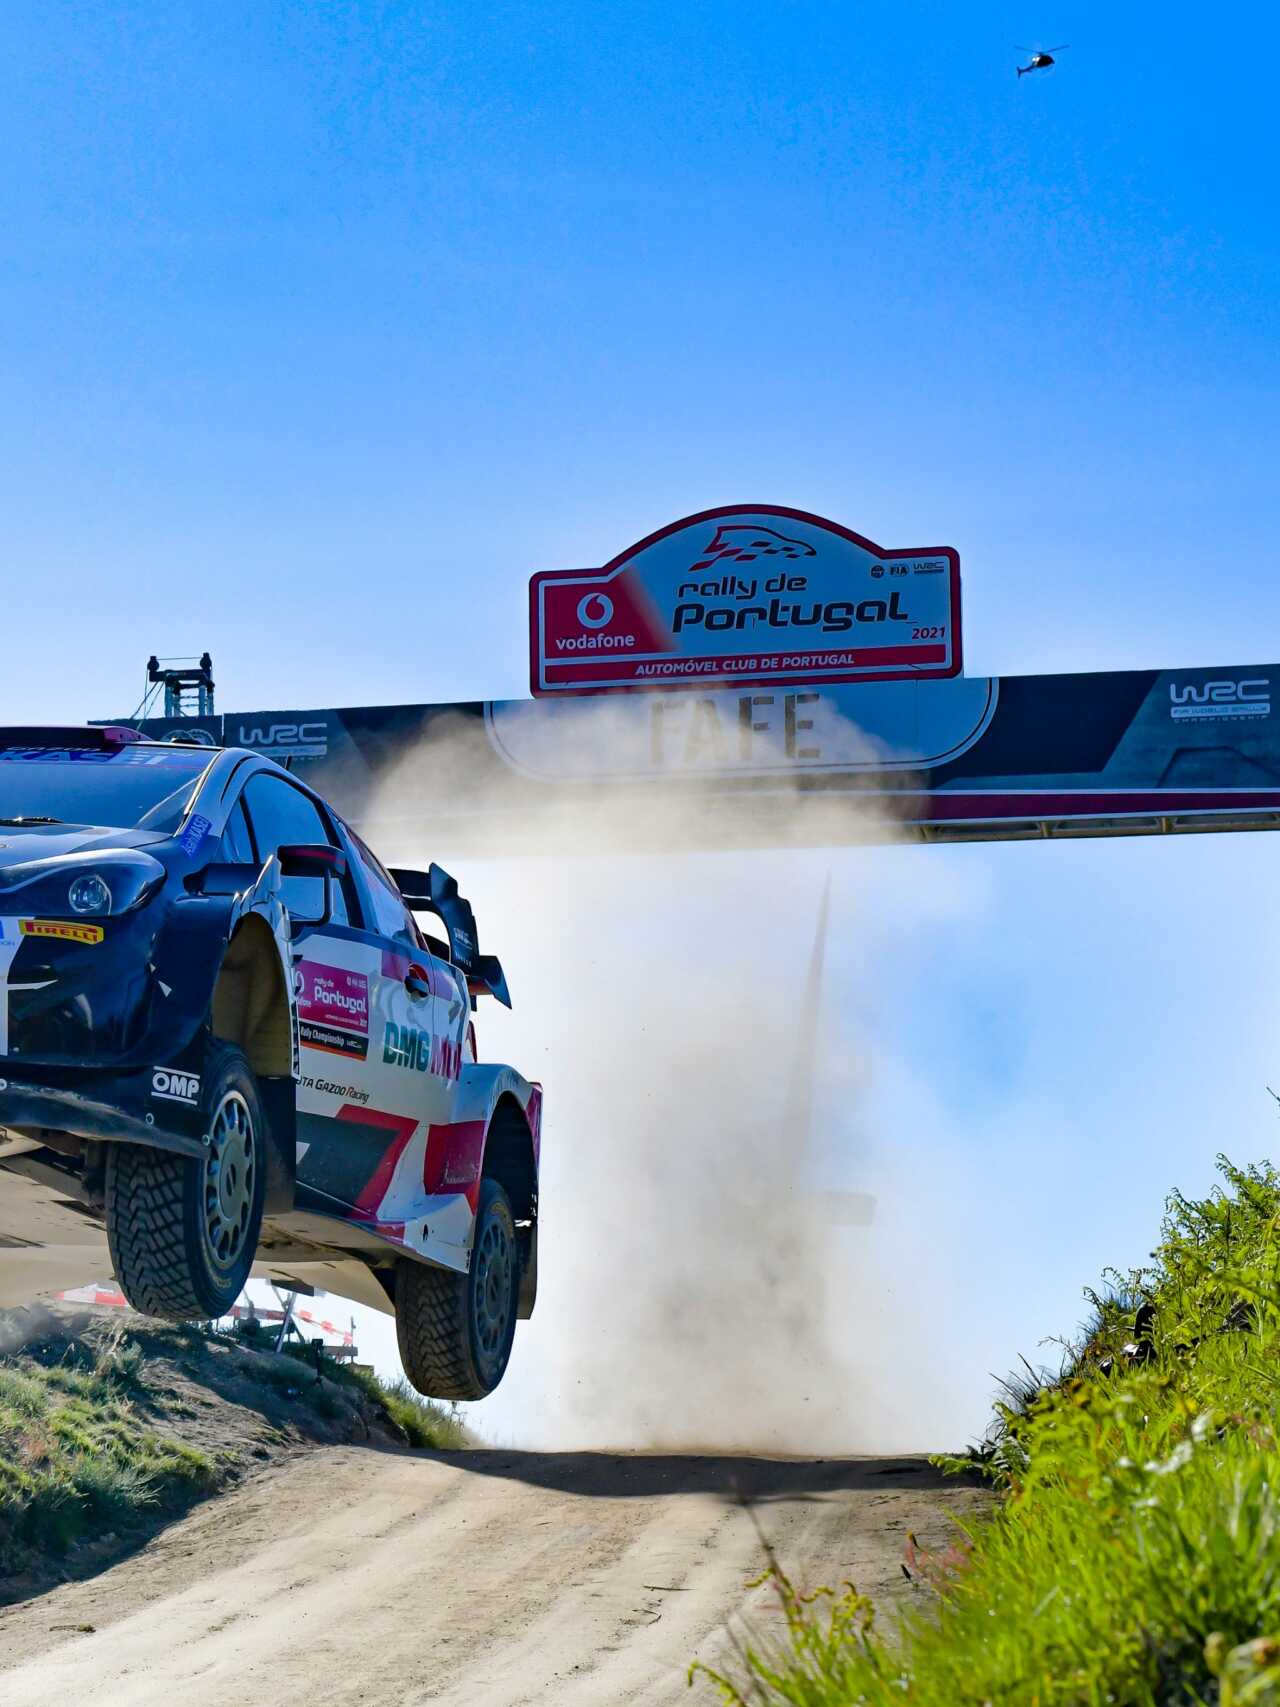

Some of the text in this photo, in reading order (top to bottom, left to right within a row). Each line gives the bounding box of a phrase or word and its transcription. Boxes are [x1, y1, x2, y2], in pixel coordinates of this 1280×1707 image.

[677, 573, 808, 600] rally de
[671, 591, 909, 633] Portugal
[555, 633, 636, 650] vodafone
[911, 626, 946, 640] 2021
[635, 654, 855, 676] AUTOMÓVEL CLUB DE PORTUGAL
[1170, 679, 1270, 703] WRC
[239, 723, 328, 745] WRC
[651, 692, 820, 765] FAFE
[23, 921, 98, 943] PIRELLI
[314, 985, 368, 1014] Portugal
[383, 1021, 430, 1072] DMG
[152, 1072, 200, 1098] OMP
